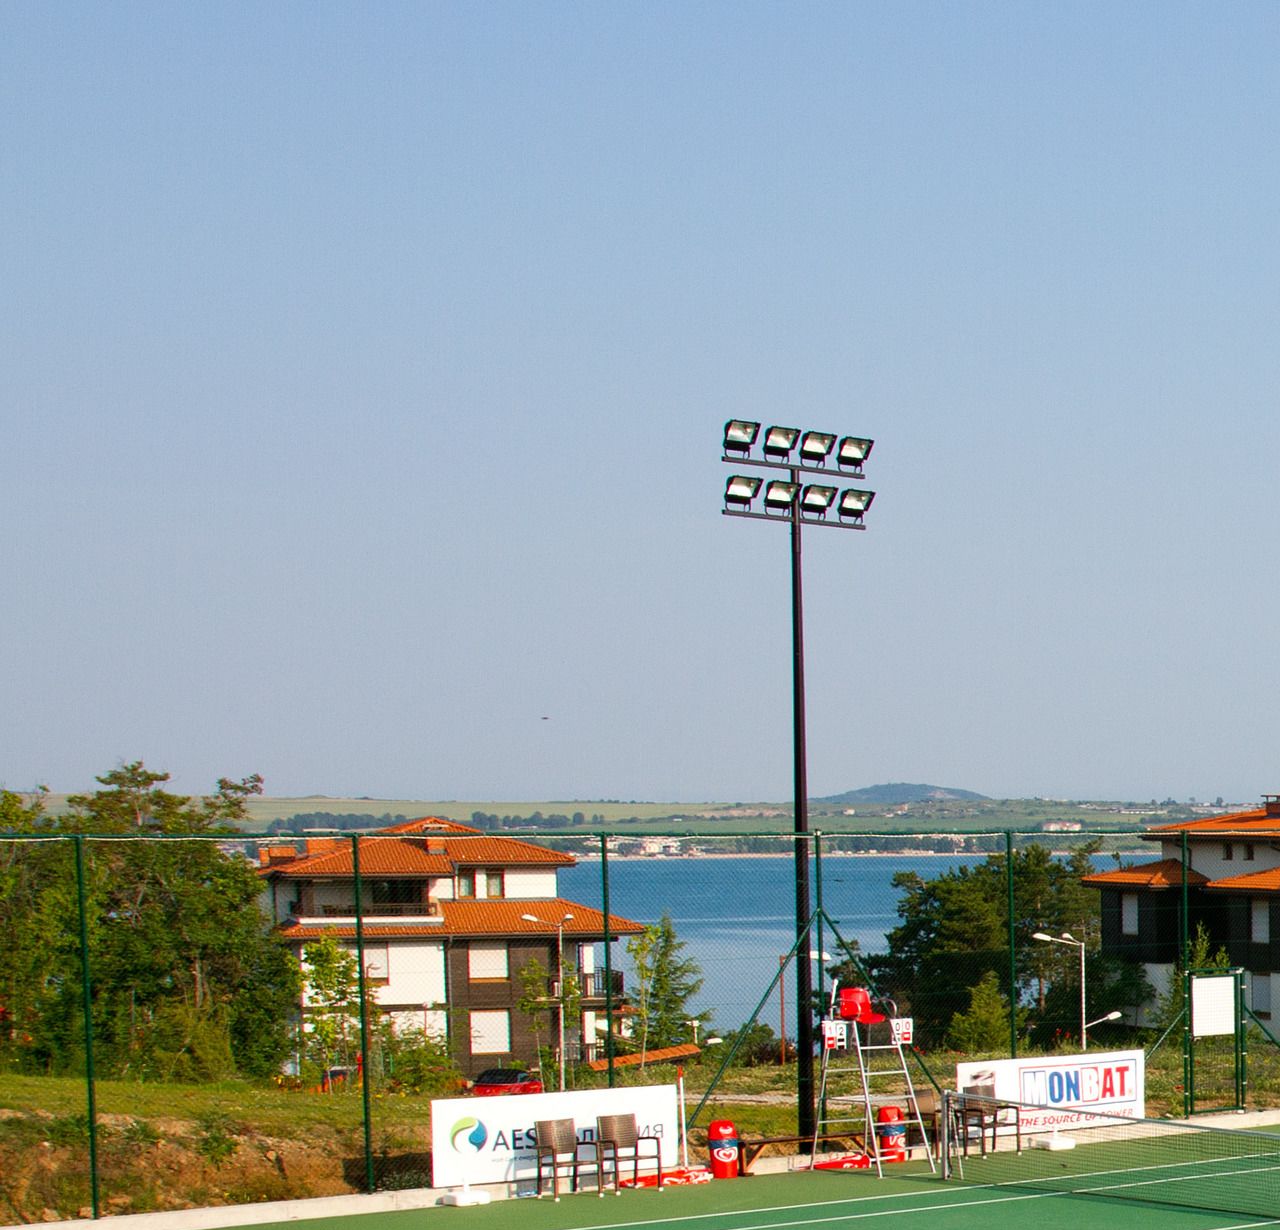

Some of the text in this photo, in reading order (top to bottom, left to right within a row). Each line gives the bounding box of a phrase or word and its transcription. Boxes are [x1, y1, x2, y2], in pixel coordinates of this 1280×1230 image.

[1023, 1066, 1130, 1105] MONBAT
[1020, 1117, 1039, 1127] THE
[1042, 1113, 1082, 1126] SOURCE
[493, 1128, 538, 1152] AES
